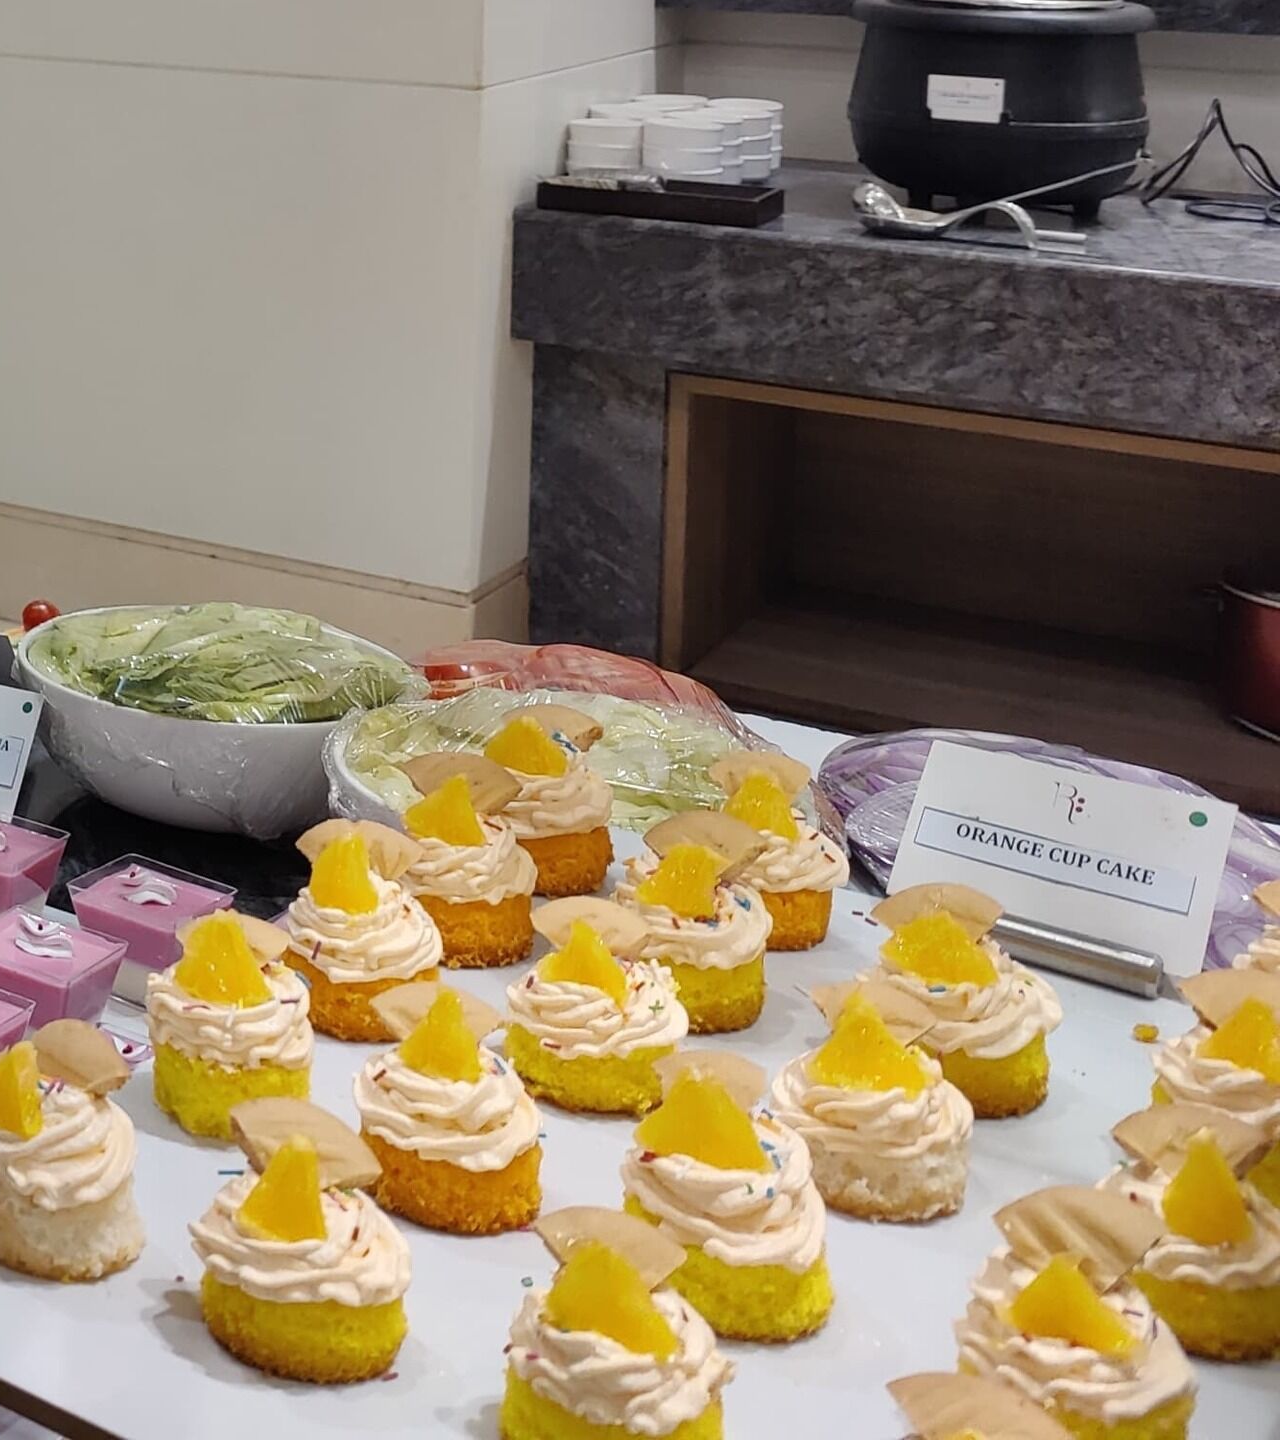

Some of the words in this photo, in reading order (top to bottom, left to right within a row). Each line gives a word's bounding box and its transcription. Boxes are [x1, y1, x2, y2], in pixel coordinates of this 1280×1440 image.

[956, 823, 1044, 859] ORANGE
[1048, 847, 1092, 869] CUP
[1096, 858, 1156, 886] CAKE
